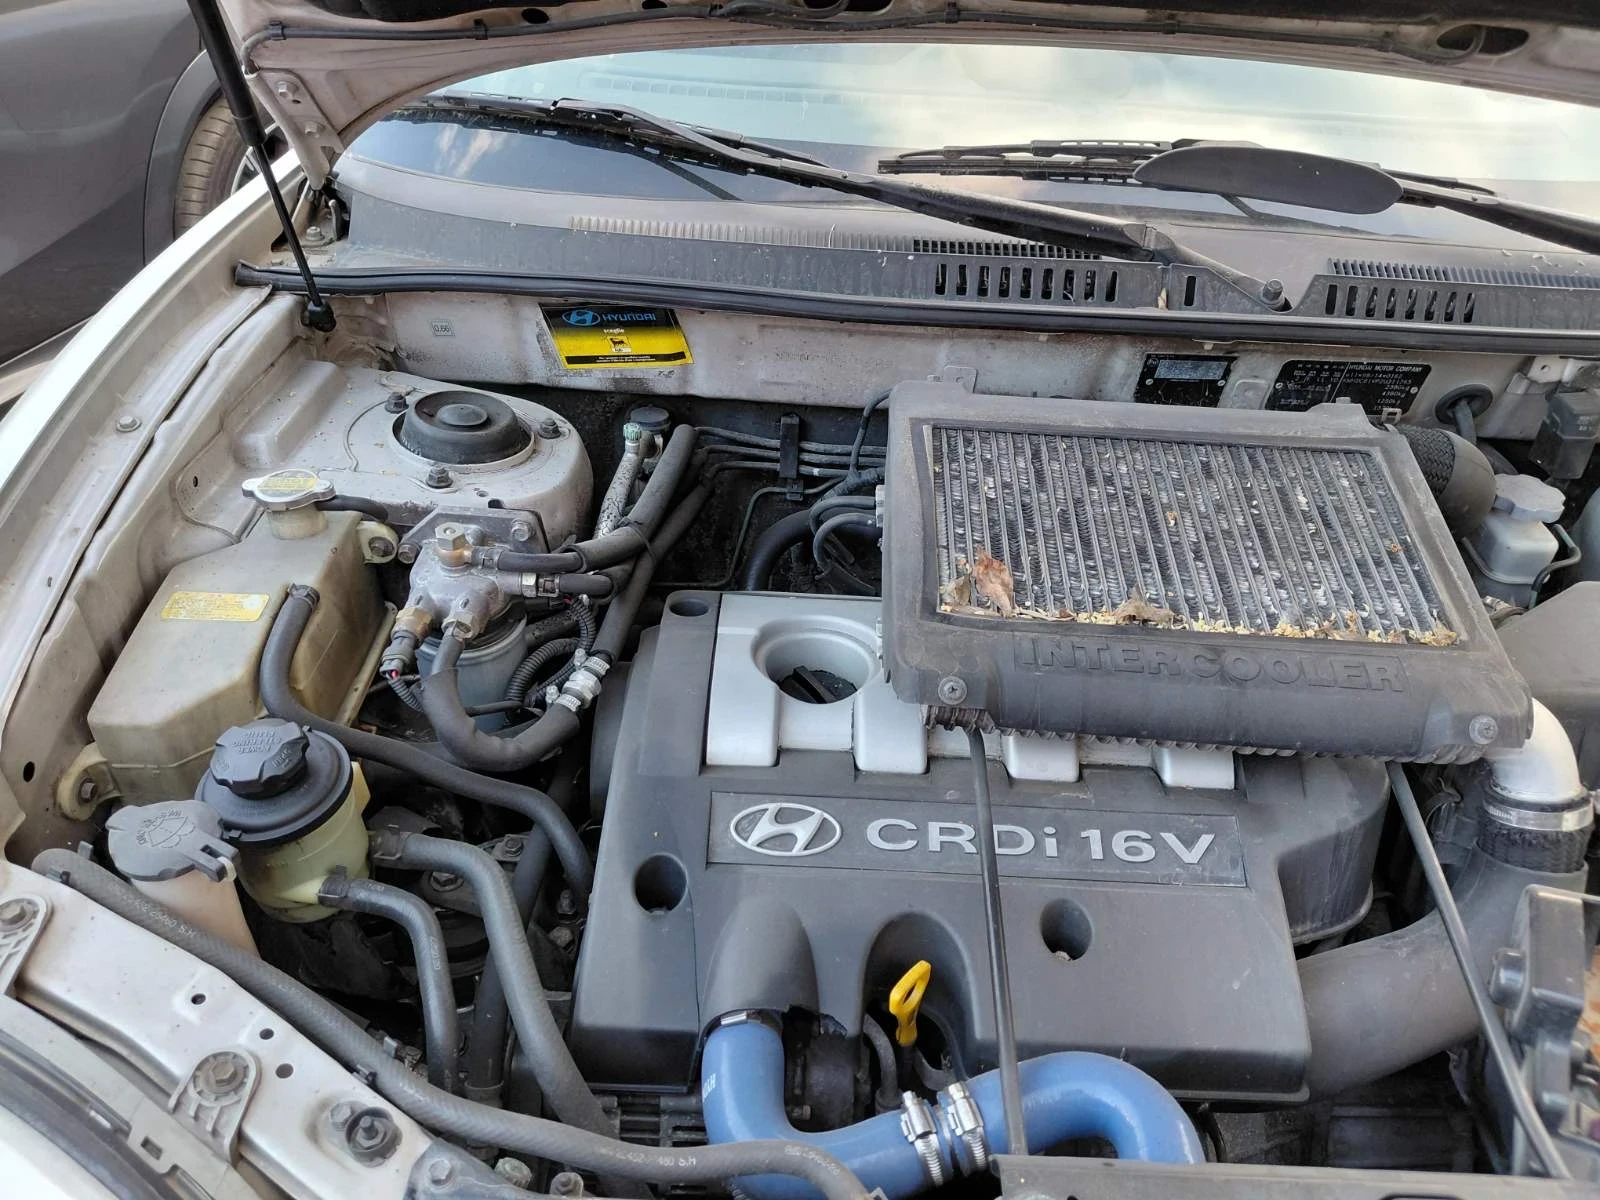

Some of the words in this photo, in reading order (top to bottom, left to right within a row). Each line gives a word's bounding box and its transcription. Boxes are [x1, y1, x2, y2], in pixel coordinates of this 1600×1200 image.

[602, 311, 656, 321] HYUNDAI
[1018, 637, 1404, 692] INTERCOOLER
[866, 818, 1058, 859] CRDi
[1079, 827, 1217, 865] 16V
